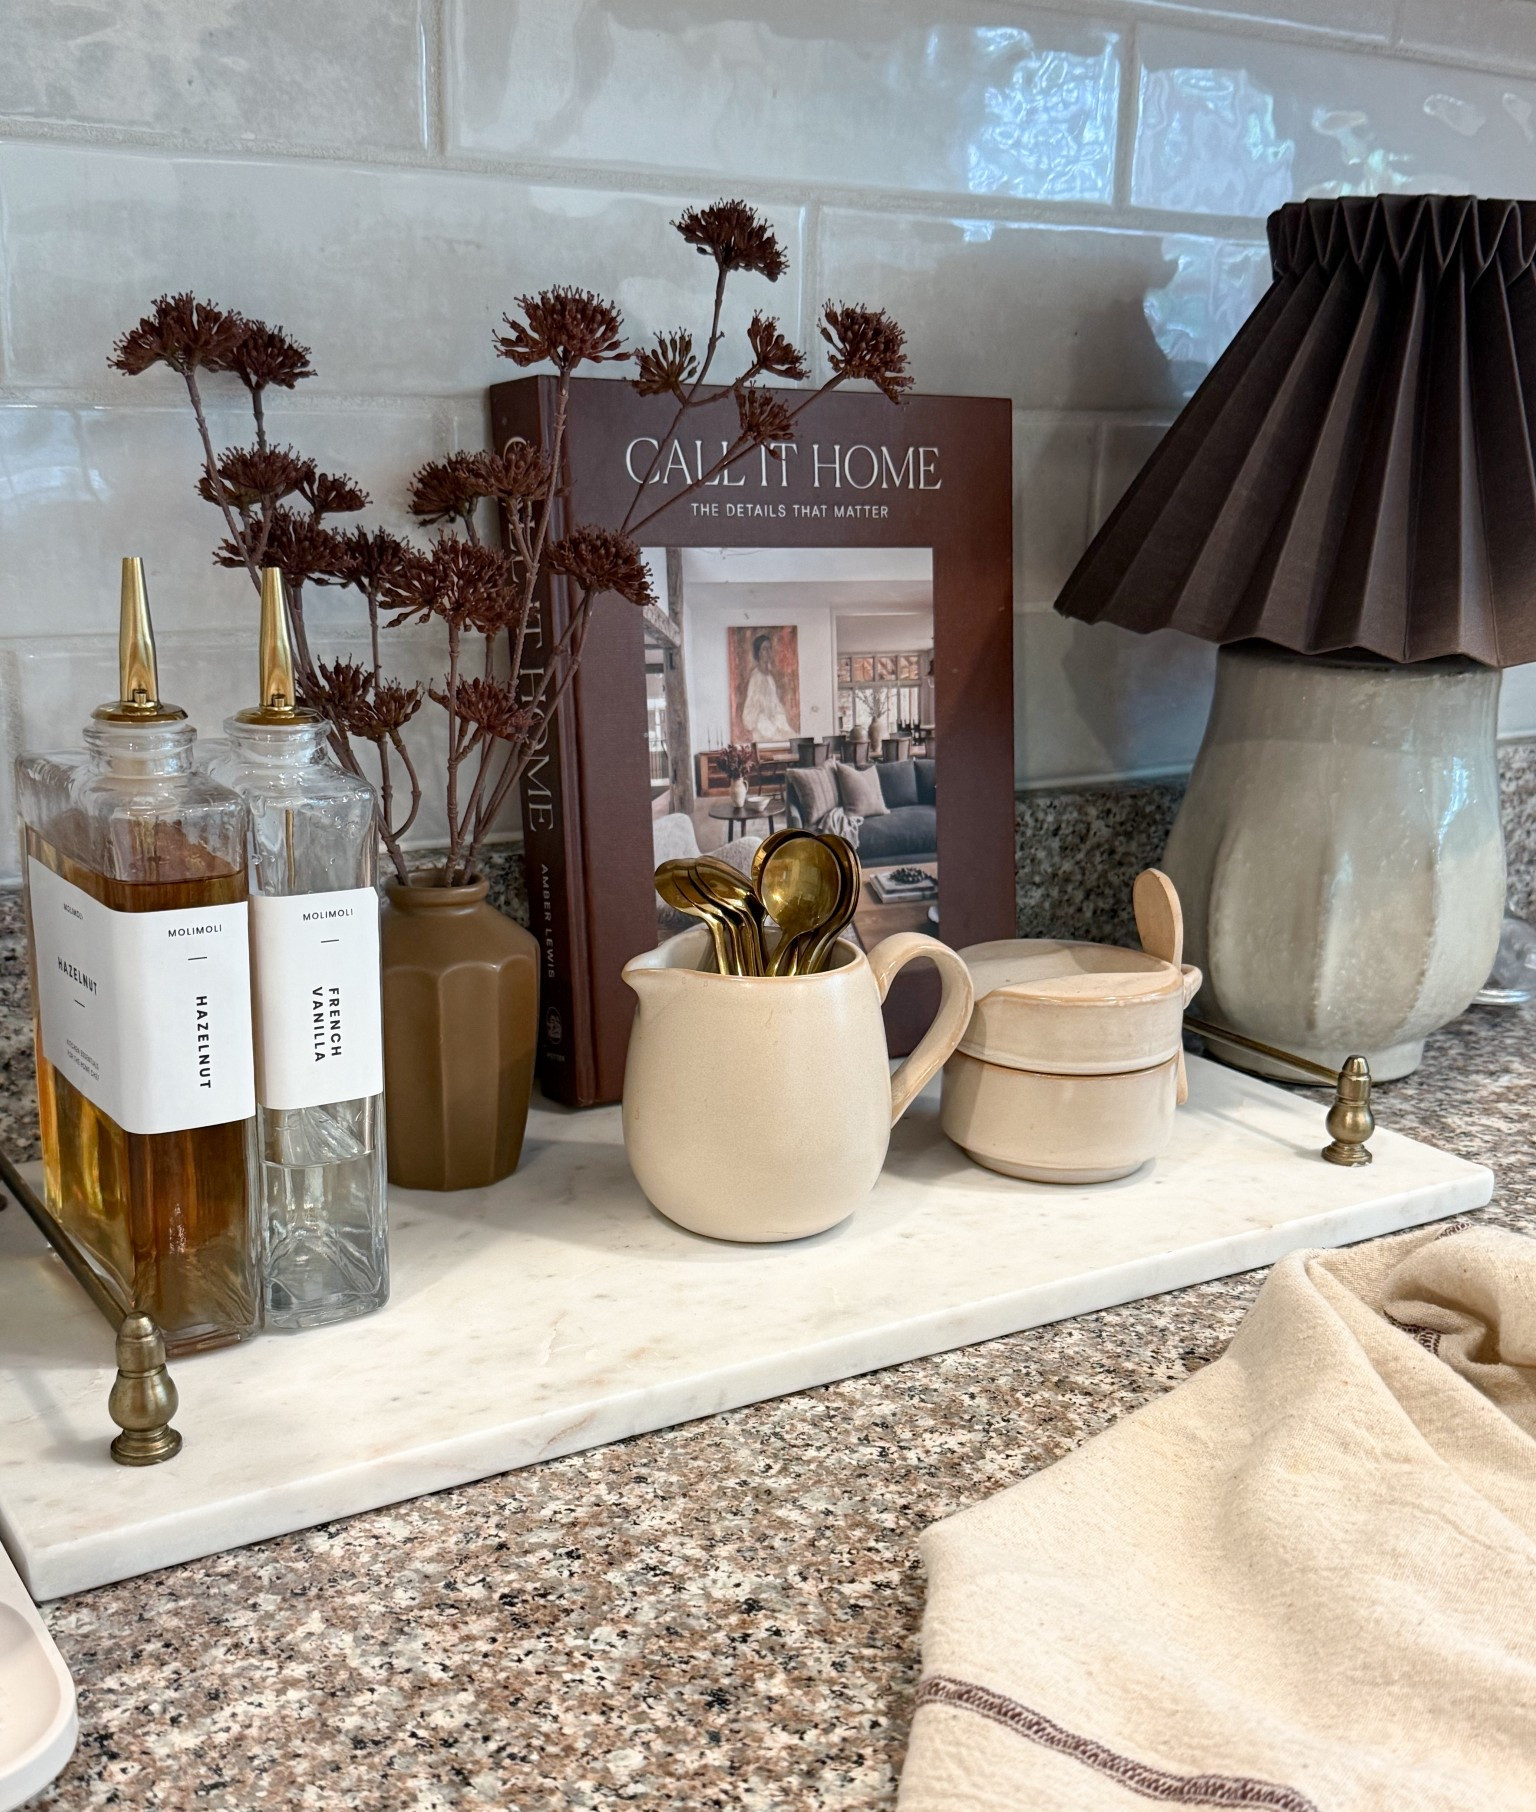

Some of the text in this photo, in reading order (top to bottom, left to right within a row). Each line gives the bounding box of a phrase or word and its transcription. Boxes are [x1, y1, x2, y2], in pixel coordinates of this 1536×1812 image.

[625, 437, 942, 490] CALL IT HOME
[691, 503, 889, 519] THE DETAILS THAT MATTER
[168, 924, 222, 937] MOLIMOLI
[303, 908, 354, 921] MOLIMOLI
[541, 863, 556, 979] AMBER LEWIS
[57, 956, 98, 996] HAZELNUT
[196, 995, 212, 1089] HAZELNUT
[312, 986, 326, 1063] VANILLA
[328, 987, 342, 1057] FRENCH
